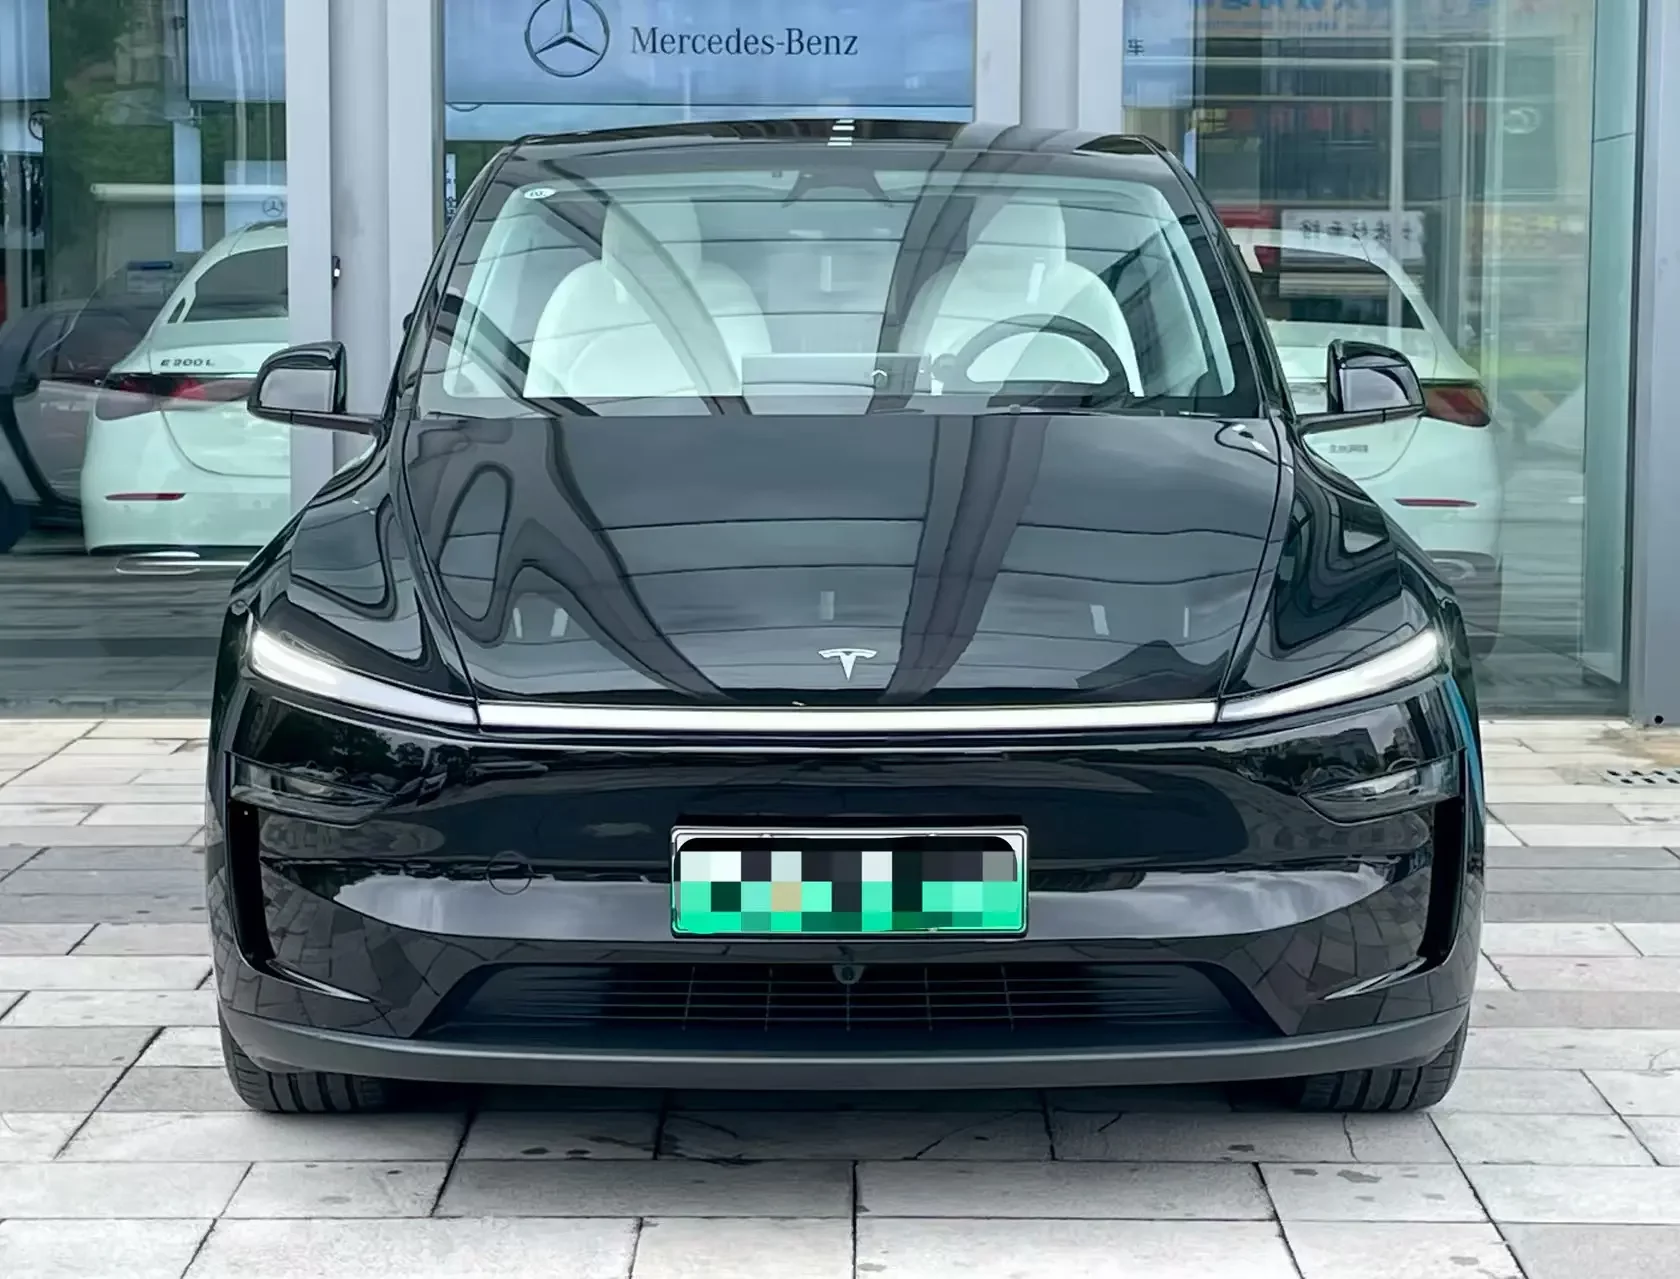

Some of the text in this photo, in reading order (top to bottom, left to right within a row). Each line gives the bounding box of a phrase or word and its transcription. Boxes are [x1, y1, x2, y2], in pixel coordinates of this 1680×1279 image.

[631, 26, 859, 56] Mercedes-Benz
[160, 358, 171, 367] E
[206, 358, 216, 367] L
